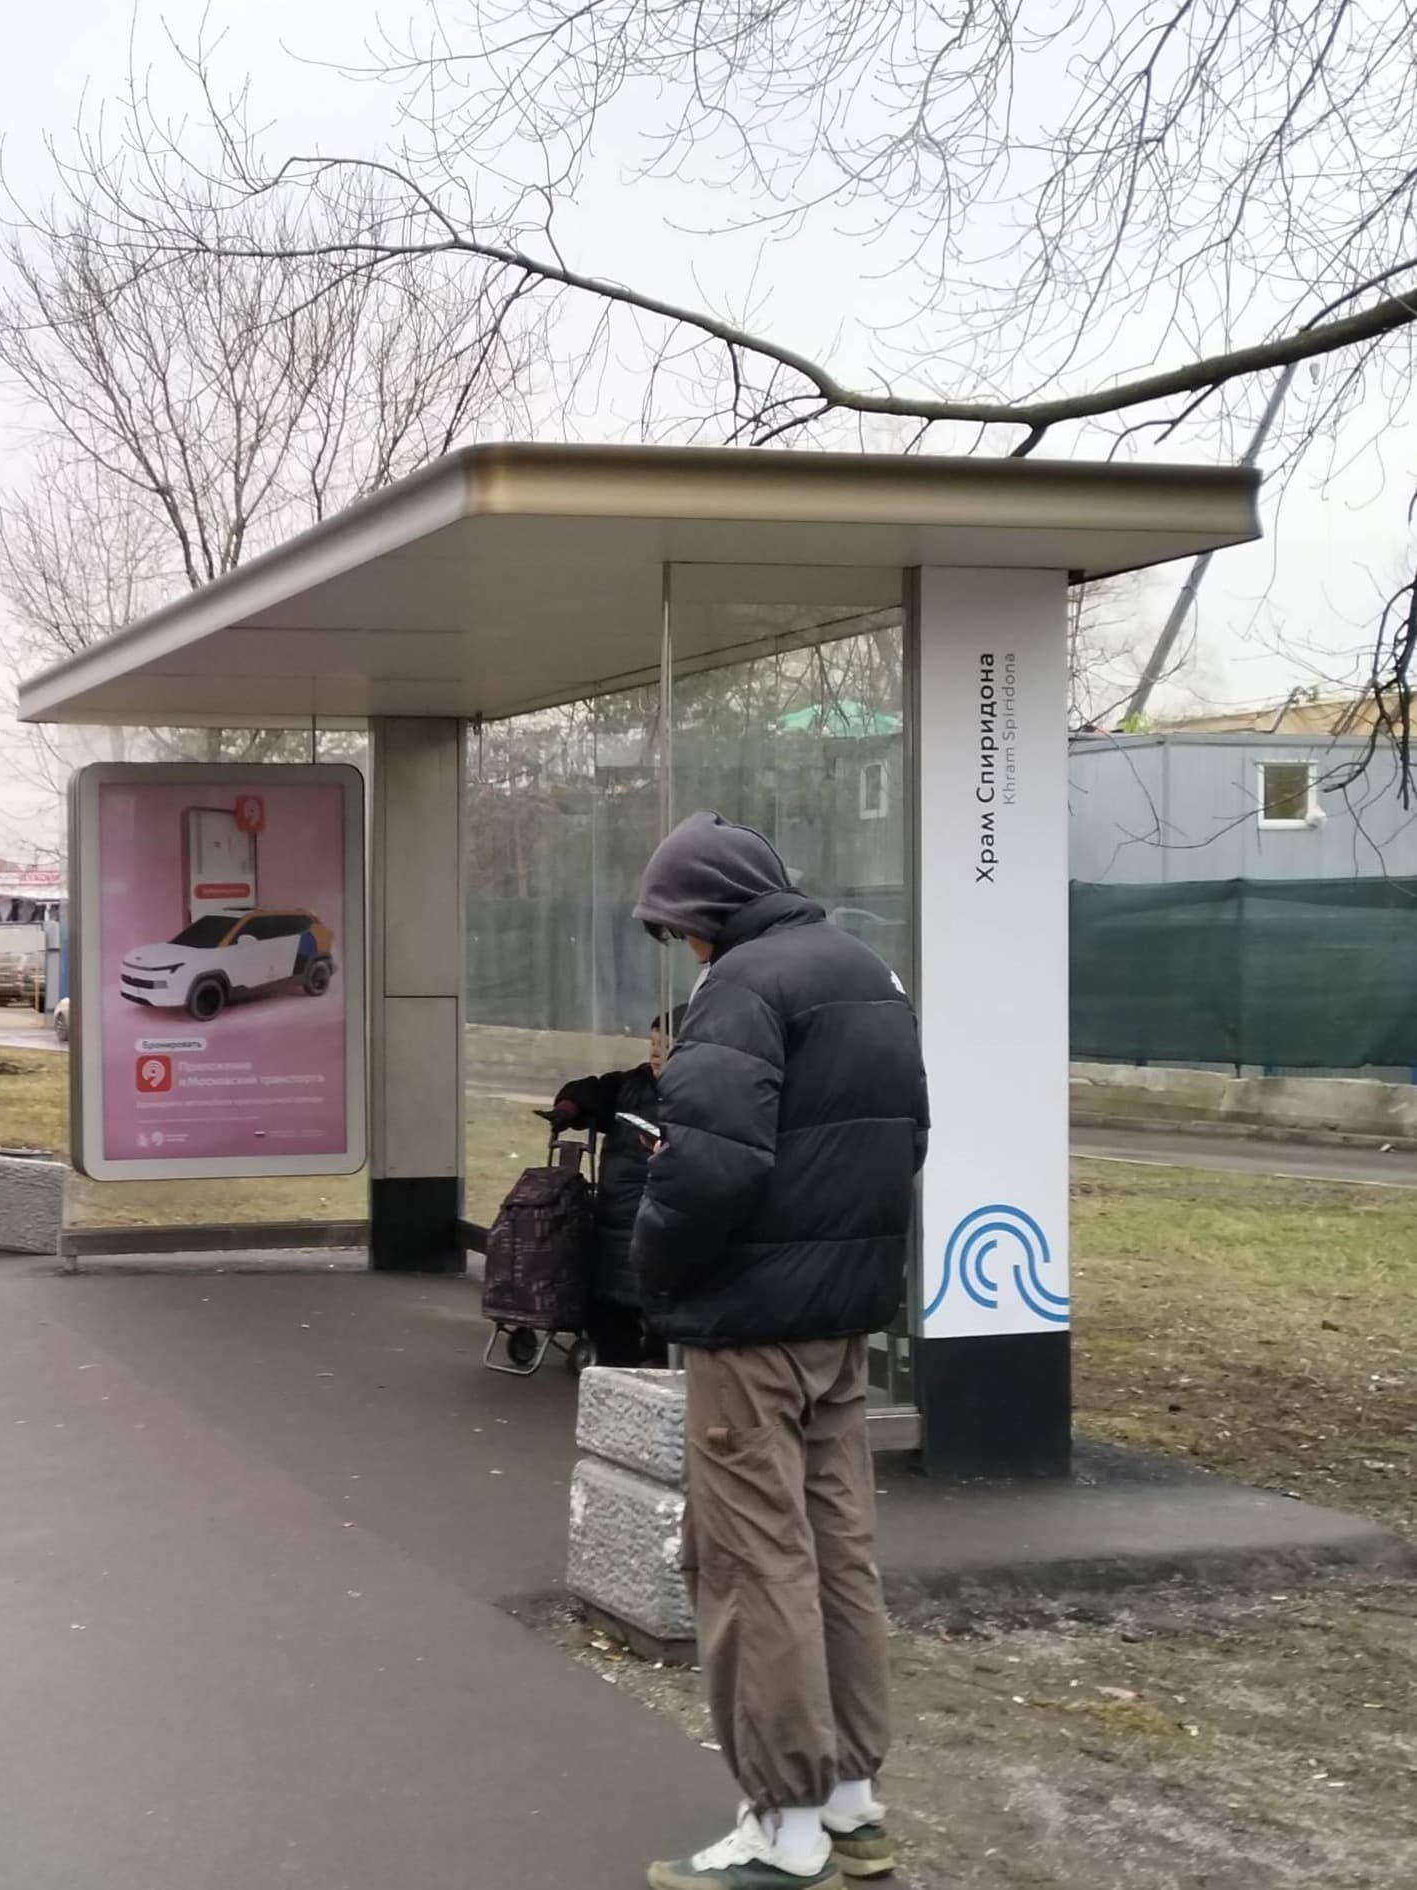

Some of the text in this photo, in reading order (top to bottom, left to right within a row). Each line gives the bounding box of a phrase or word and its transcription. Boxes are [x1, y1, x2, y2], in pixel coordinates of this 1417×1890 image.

[975, 652, 999, 883] Храм Спиридона
[1002, 652, 1018, 805] Khram Spiridona
